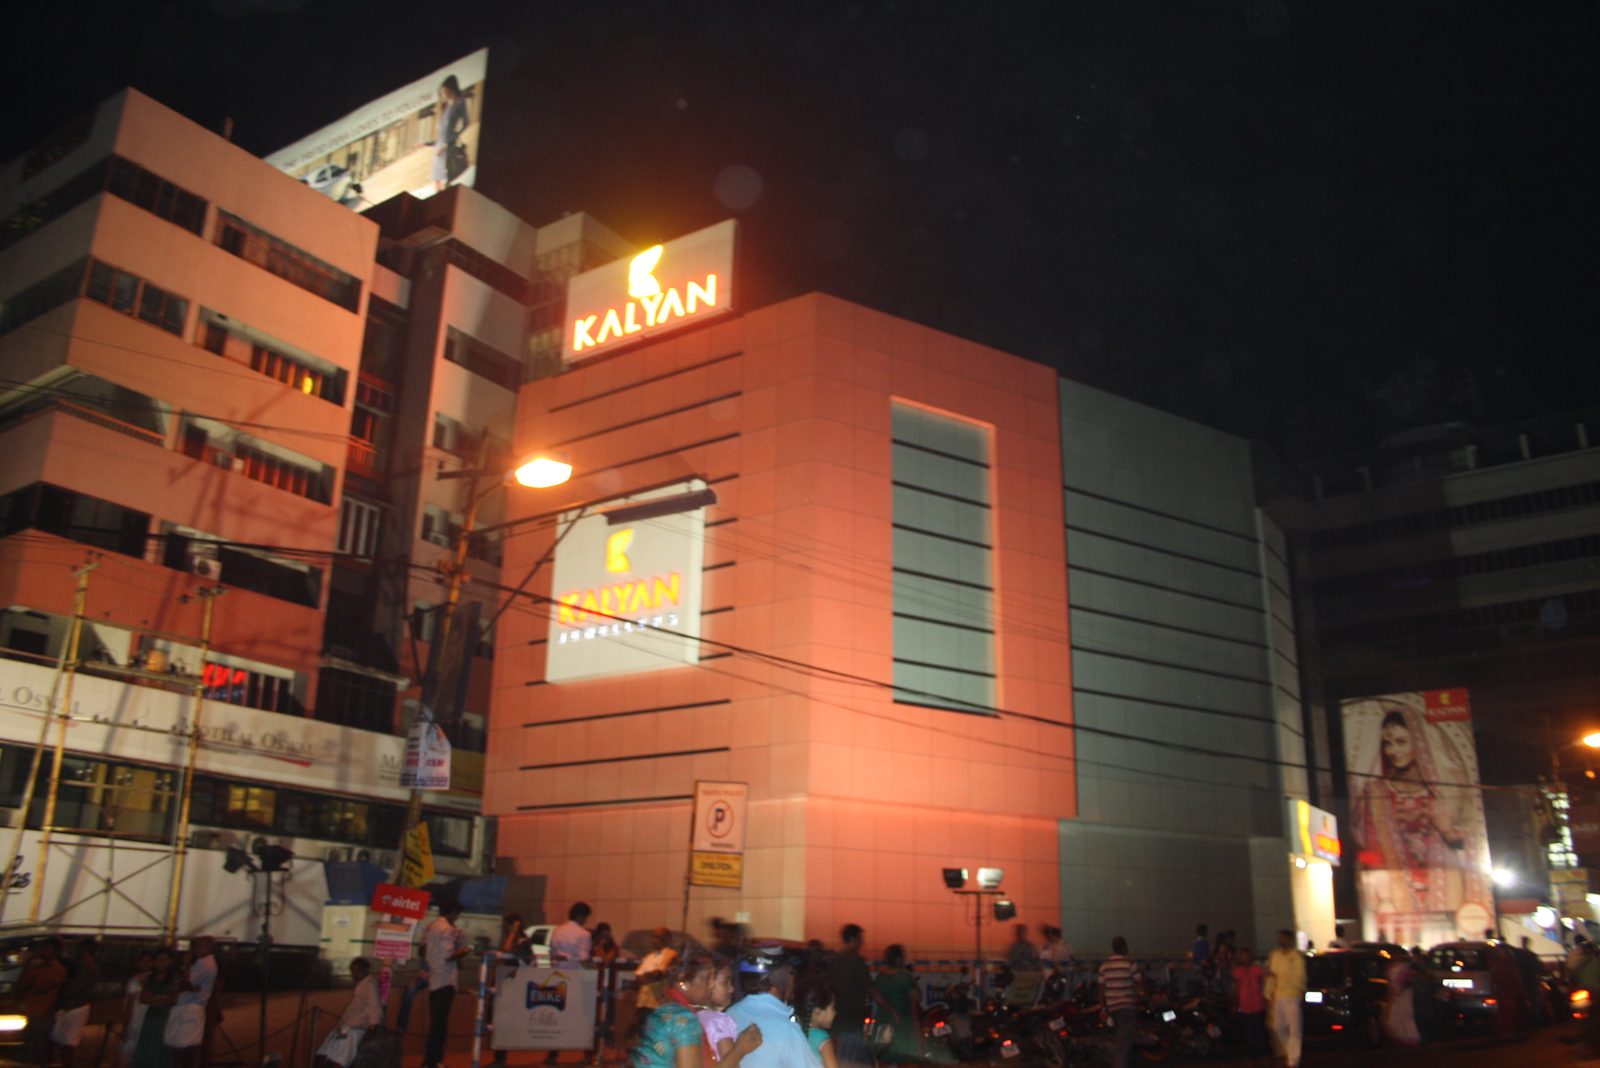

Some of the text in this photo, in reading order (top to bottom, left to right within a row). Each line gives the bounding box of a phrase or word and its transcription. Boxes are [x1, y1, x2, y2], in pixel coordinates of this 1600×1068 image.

[572, 273, 718, 352] KALYAN
[558, 571, 681, 626] KALYAN
[390, 894, 422, 912] airtel
